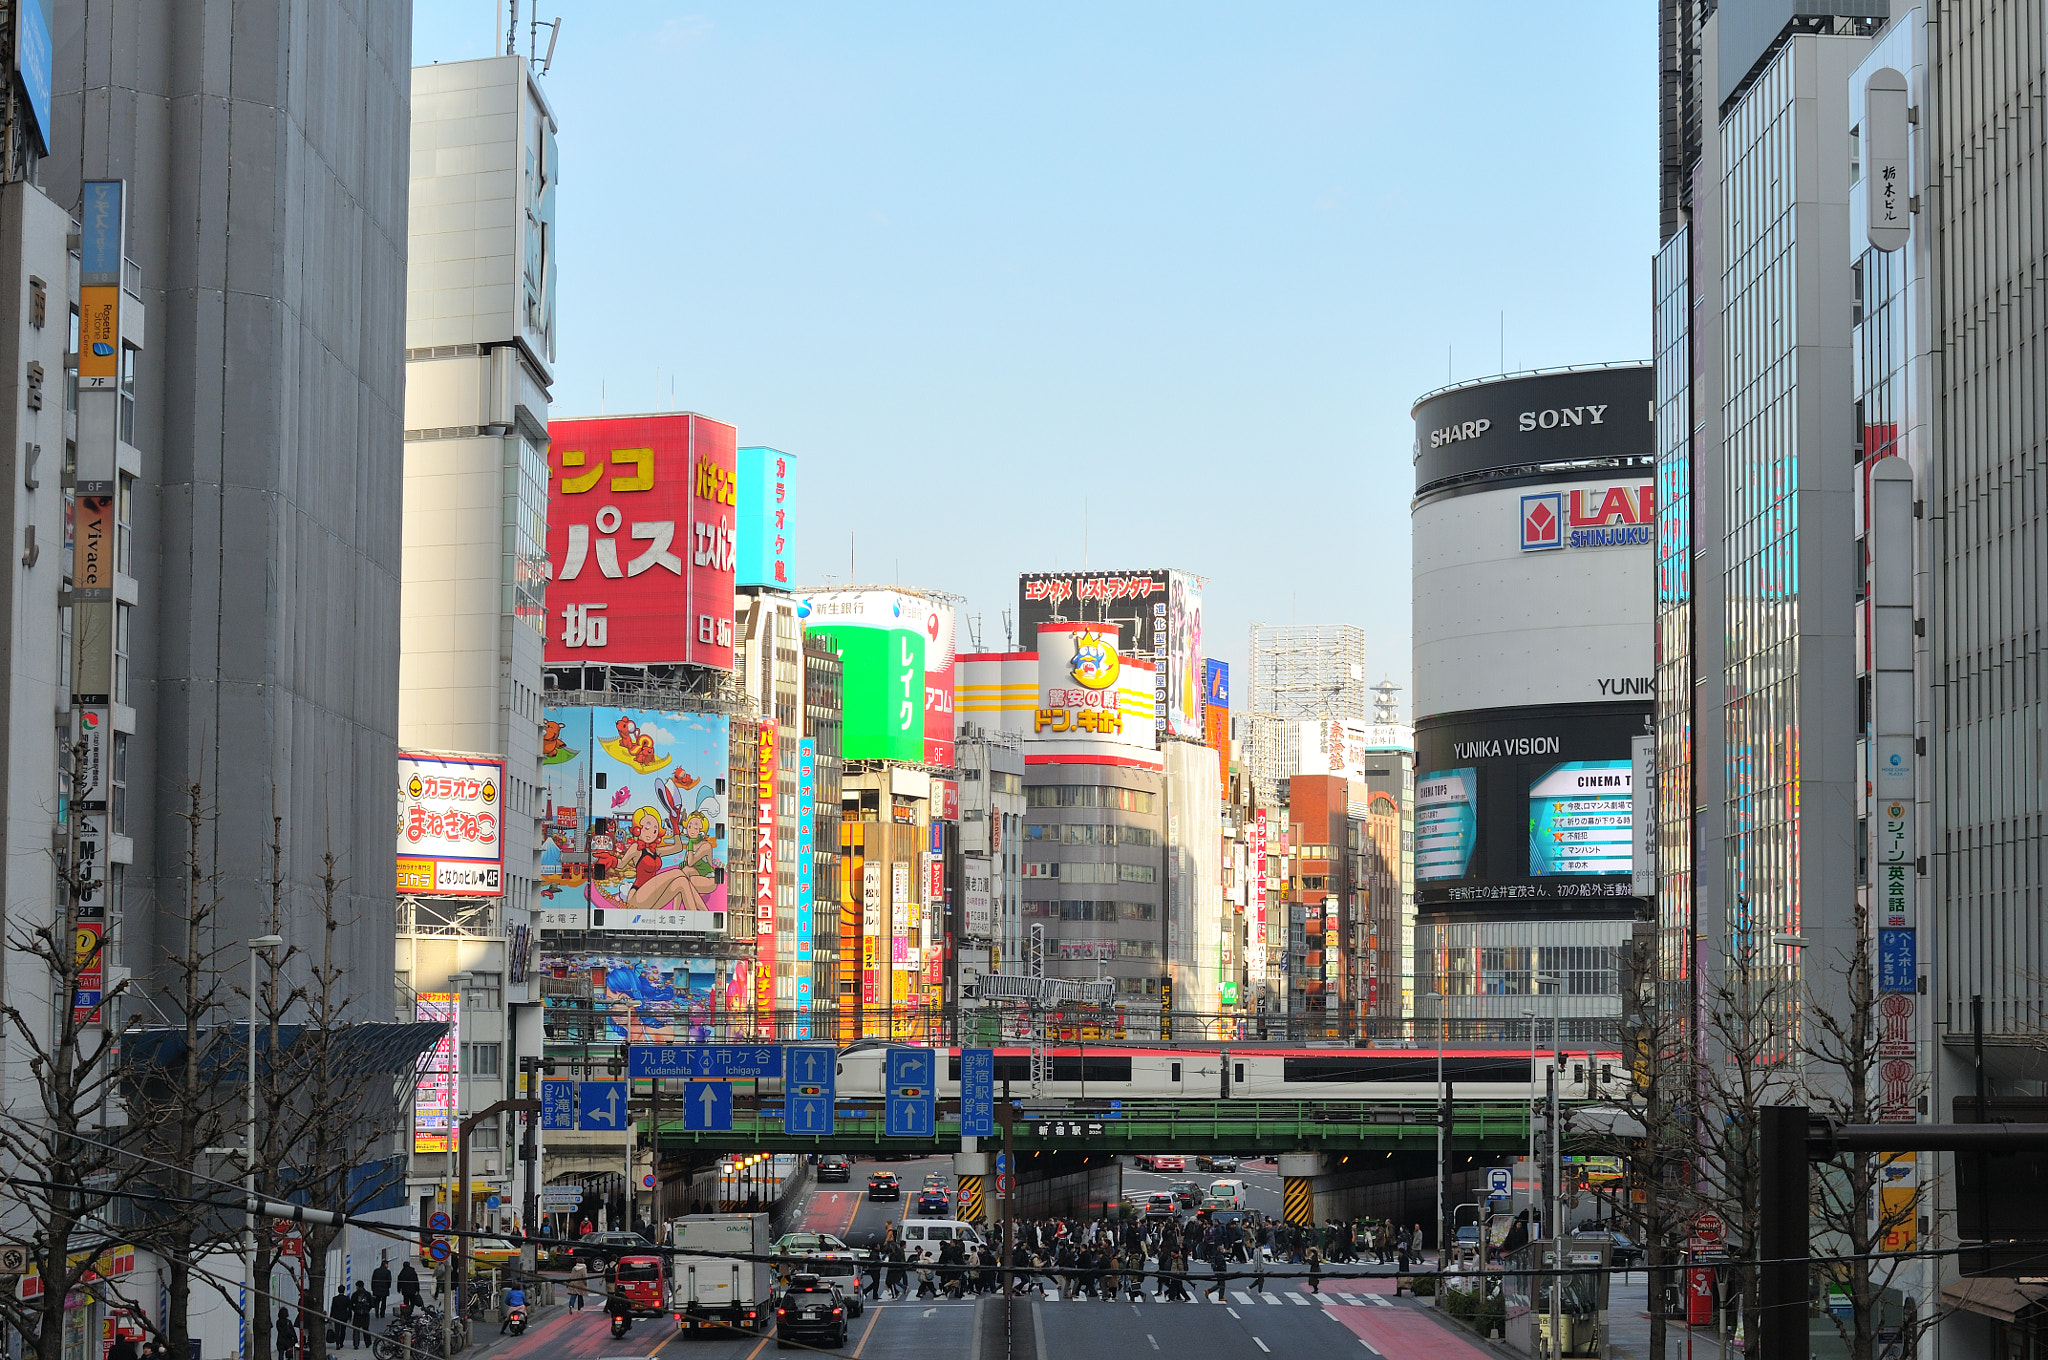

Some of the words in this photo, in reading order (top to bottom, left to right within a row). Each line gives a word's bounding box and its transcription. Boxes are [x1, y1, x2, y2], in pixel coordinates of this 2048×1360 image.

[1882, 166, 1897, 221] 栃木ビル
[103, 304, 112, 340] Rosetta
[91, 377, 105, 386] 7F
[1430, 418, 1491, 449] SHARP
[1519, 404, 1607, 432] SONY
[88, 482, 103, 491] 6F
[696, 453, 736, 506] パチンコ
[695, 514, 735, 573] エスパス
[1571, 527, 1649, 548] SHINJUKU
[86, 519, 102, 584] Vivace
[85, 588, 100, 597] 5F
[1026, 580, 1072, 600] エンタメ
[1077, 576, 1165, 599] レストランタワー
[816, 602, 864, 615] 新生銀行
[698, 614, 731, 648] 日拓
[901, 636, 914, 730] レイク
[926, 687, 953, 713] アコム
[934, 747, 943, 761] 3F
[1454, 739, 1502, 759] YUNIKA
[1504, 737, 1560, 756] VISION
[760, 729, 773, 798] パチンコ
[424, 777, 481, 799] カラオケ
[1577, 775, 1621, 787] CINEMA
[407, 804, 496, 842] まねきねこ
[1258, 815, 1266, 858] カラオケ
[1568, 846, 1601, 854] マンハント
[438, 869, 478, 886] となりのビル
[487, 870, 498, 885] 4F
[866, 873, 874, 925] 小松ビル
[79, 907, 94, 915] 2F
[546, 914, 578, 923] 北電子
[659, 915, 686, 924] 北電子
[1898, 932, 1911, 986] ベースボール
[78, 993, 91, 1005] 酒
[1225, 985, 1236, 999] レイク
[640, 1050, 697, 1065] 九段下
[703, 1057, 709, 1065] 4
[645, 1067, 692, 1075] Kudanshita
[726, 1066, 761, 1076] Ichigaya
[964, 1056, 974, 1096] Shinjuku
[543, 1084, 553, 1104] Otaki
[975, 1054, 990, 1131] 新宿駅東口
[543, 1107, 553, 1127] Brdg.
[554, 1085, 571, 1127] 小滝橋
[1038, 1124, 1082, 1136] 新宿駅
